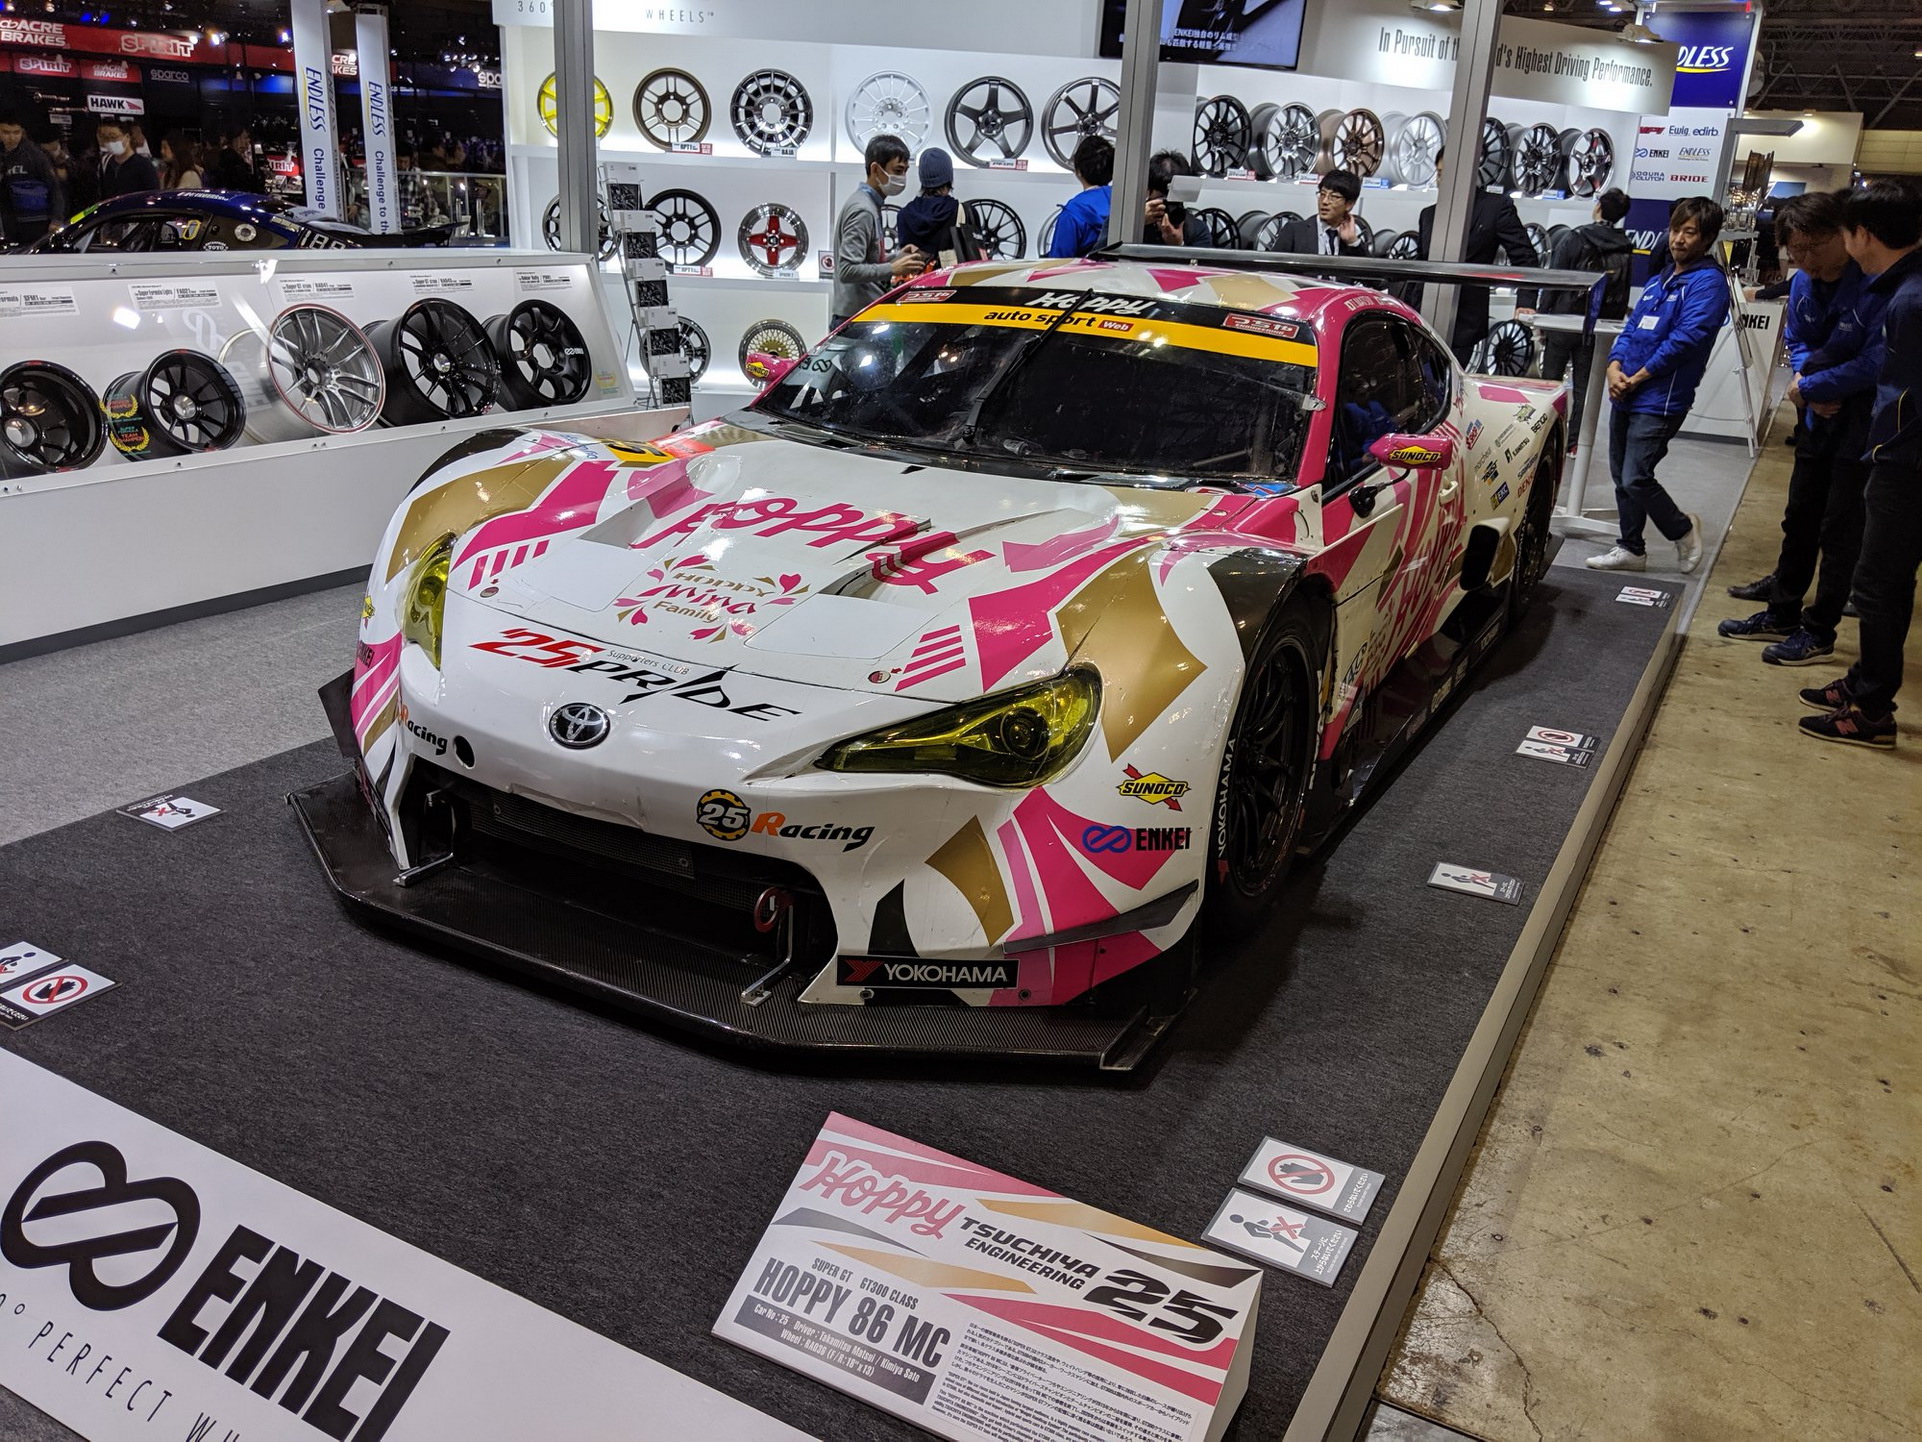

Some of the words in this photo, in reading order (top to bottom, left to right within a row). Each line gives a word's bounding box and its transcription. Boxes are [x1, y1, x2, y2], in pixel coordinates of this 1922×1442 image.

[0, 32, 66, 47] BRAKES
[1379, 27, 1391, 52] In
[1395, 29, 1436, 59] Pursuit
[1438, 35, 1451, 61] of
[19, 58, 72, 74] SPIRIT
[94, 70, 128, 79] BRAKES
[1515, 46, 1553, 75] Highest
[1554, 51, 1590, 82] Driving
[1592, 56, 1654, 88] Performance.
[90, 97, 126, 110] HAWK
[305, 66, 327, 133] ENDLESS
[368, 81, 386, 138] ENDLESS
[1649, 149, 1669, 159] ENKEI
[313, 148, 326, 210] Challenge
[375, 150, 386, 204] Challenge
[1670, 174, 1709, 183] BRIDE
[379, 206, 386, 218] to
[984, 310, 1032, 321] auto
[1034, 313, 1097, 327] sport
[1103, 320, 1130, 332] Web
[747, 364, 770, 377] SUNOCO
[1390, 450, 1441, 462] SUNOCO
[637, 583, 758, 616] Mina
[672, 570, 775, 598] HOPPY
[653, 600, 720, 624] Family
[468, 627, 607, 669] 25
[607, 649, 660, 667] Supporters
[661, 663, 690, 676] CLUB
[1122, 782, 1186, 796] SUNOCO
[1217, 738, 1238, 859] YOKOHAMA
[699, 803, 751, 829] 25
[751, 811, 876, 853] Racing
[1135, 826, 1192, 852] ENKEI
[884, 963, 1008, 983] YOKOHAMA
[798, 1155, 967, 1241] Hoppy
[959, 1216, 1102, 1279] TSUCHIYA
[964, 1236, 1087, 1291] ENGINEERING
[812, 1257, 839, 1279] SUPER
[839, 1268, 853, 1283] GT
[860, 1277, 888, 1299] GT300
[889, 1289, 919, 1311] CLASS
[752, 1257, 853, 1324] HOPPY
[847, 1296, 896, 1344] 86
[892, 1314, 951, 1368] MC
[1083, 1268, 1240, 1345] 25
[156, 1224, 452, 1442] ENKEI
[754, 1303, 767, 1317] Car
[779, 1313, 790, 1325] 25
[819, 1330, 853, 1353] Takamitsu
[852, 1344, 875, 1363] Matsui
[880, 1357, 903, 1376] Kimiya
[903, 1367, 921, 1382] Sato
[28, 1320, 173, 1423] PERFECT
